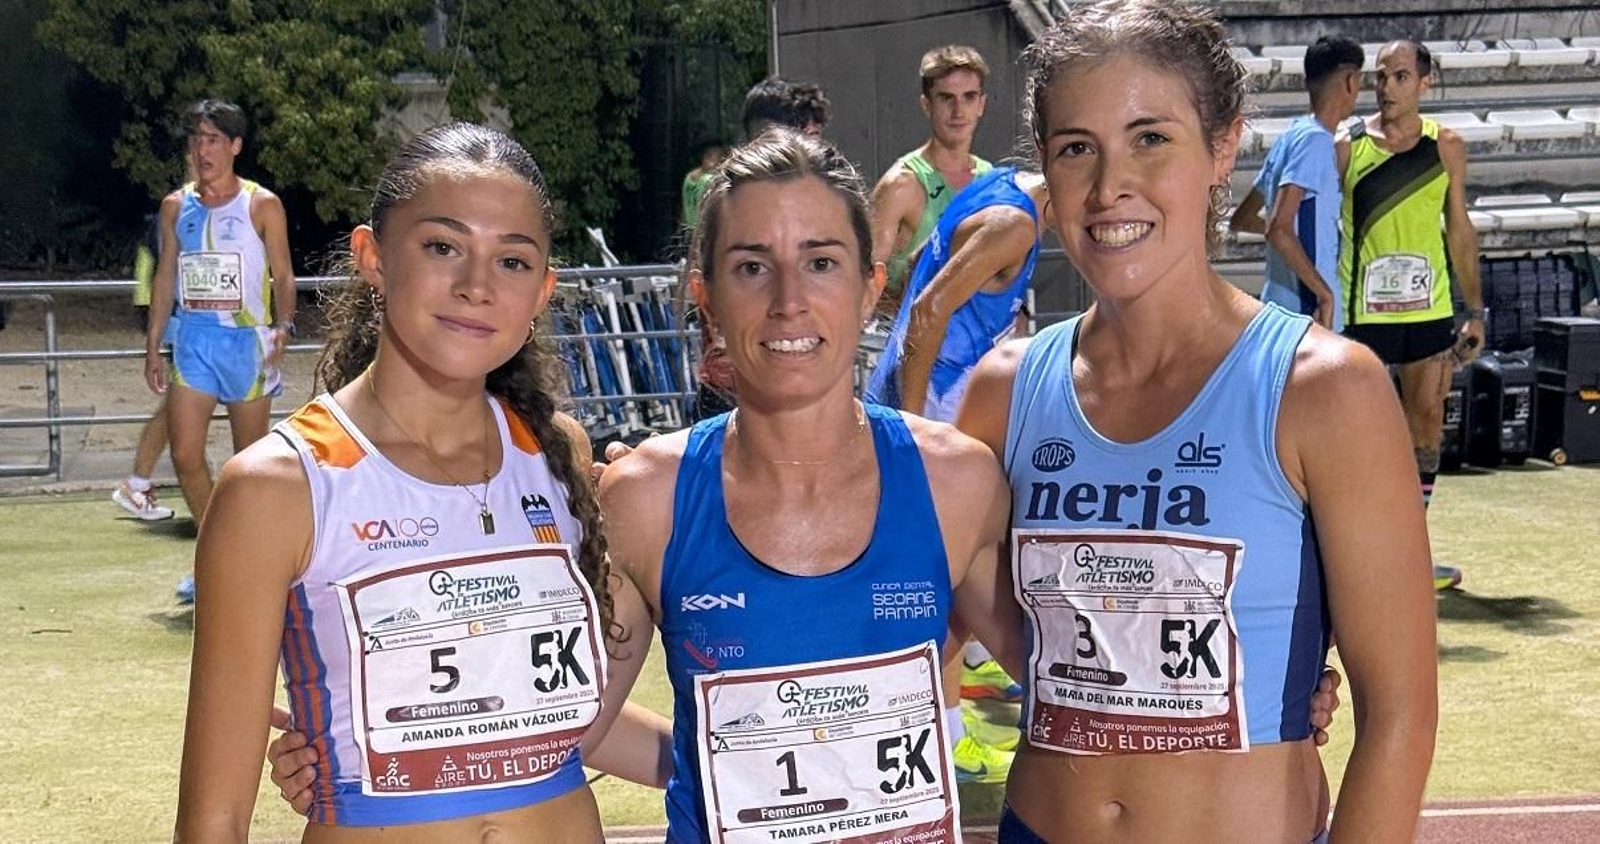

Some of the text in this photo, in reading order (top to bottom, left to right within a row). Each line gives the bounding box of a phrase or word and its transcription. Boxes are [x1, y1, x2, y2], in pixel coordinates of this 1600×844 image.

[185, 273, 217, 287] 1040
[221, 274, 238, 289] 5K
[1381, 276, 1399, 288] 16
[1034, 444, 1074, 467] TROPS
[1025, 468, 1211, 530] nerja
[368, 539, 429, 551] CENTENARIO
[1097, 555, 1155, 569] FESTIVAL
[457, 575, 518, 592] FESTIVAL
[1075, 570, 1155, 585] ATLETISMO
[437, 585, 521, 612] ATLETISMO
[872, 591, 936, 606] SEOANE
[874, 605, 937, 620] PAMPIN
[1074, 614, 1097, 659] 3
[531, 626, 590, 693] 5K
[1160, 619, 1222, 679] 5K
[429, 647, 460, 693] 5
[804, 684, 869, 700] FESTIVAL
[1087, 691, 1105, 704] DEL
[1107, 694, 1133, 708] MAR
[1137, 696, 1203, 711] MARQUÉS
[410, 701, 479, 719] Femenino
[782, 694, 870, 719] ATLETISMO
[402, 709, 580, 743] AMANDA ROMÁN VÁZQUEZ
[1089, 719, 1230, 735] Nosotros ponemos la equipación
[1086, 728, 1113, 751] TÚ,
[1118, 734, 1139, 750] EL
[1143, 733, 1227, 750] DEPORTE
[466, 749, 510, 761] Nosotros
[510, 743, 550, 759] ponemos
[550, 740, 558, 749] la
[877, 728, 936, 793] 5K
[466, 756, 498, 782] TÚ,
[503, 761, 524, 777] EL
[776, 751, 807, 797] 1
[760, 802, 825, 819] Femenino
[769, 810, 909, 840] TAMARA PÉREZ MERA
